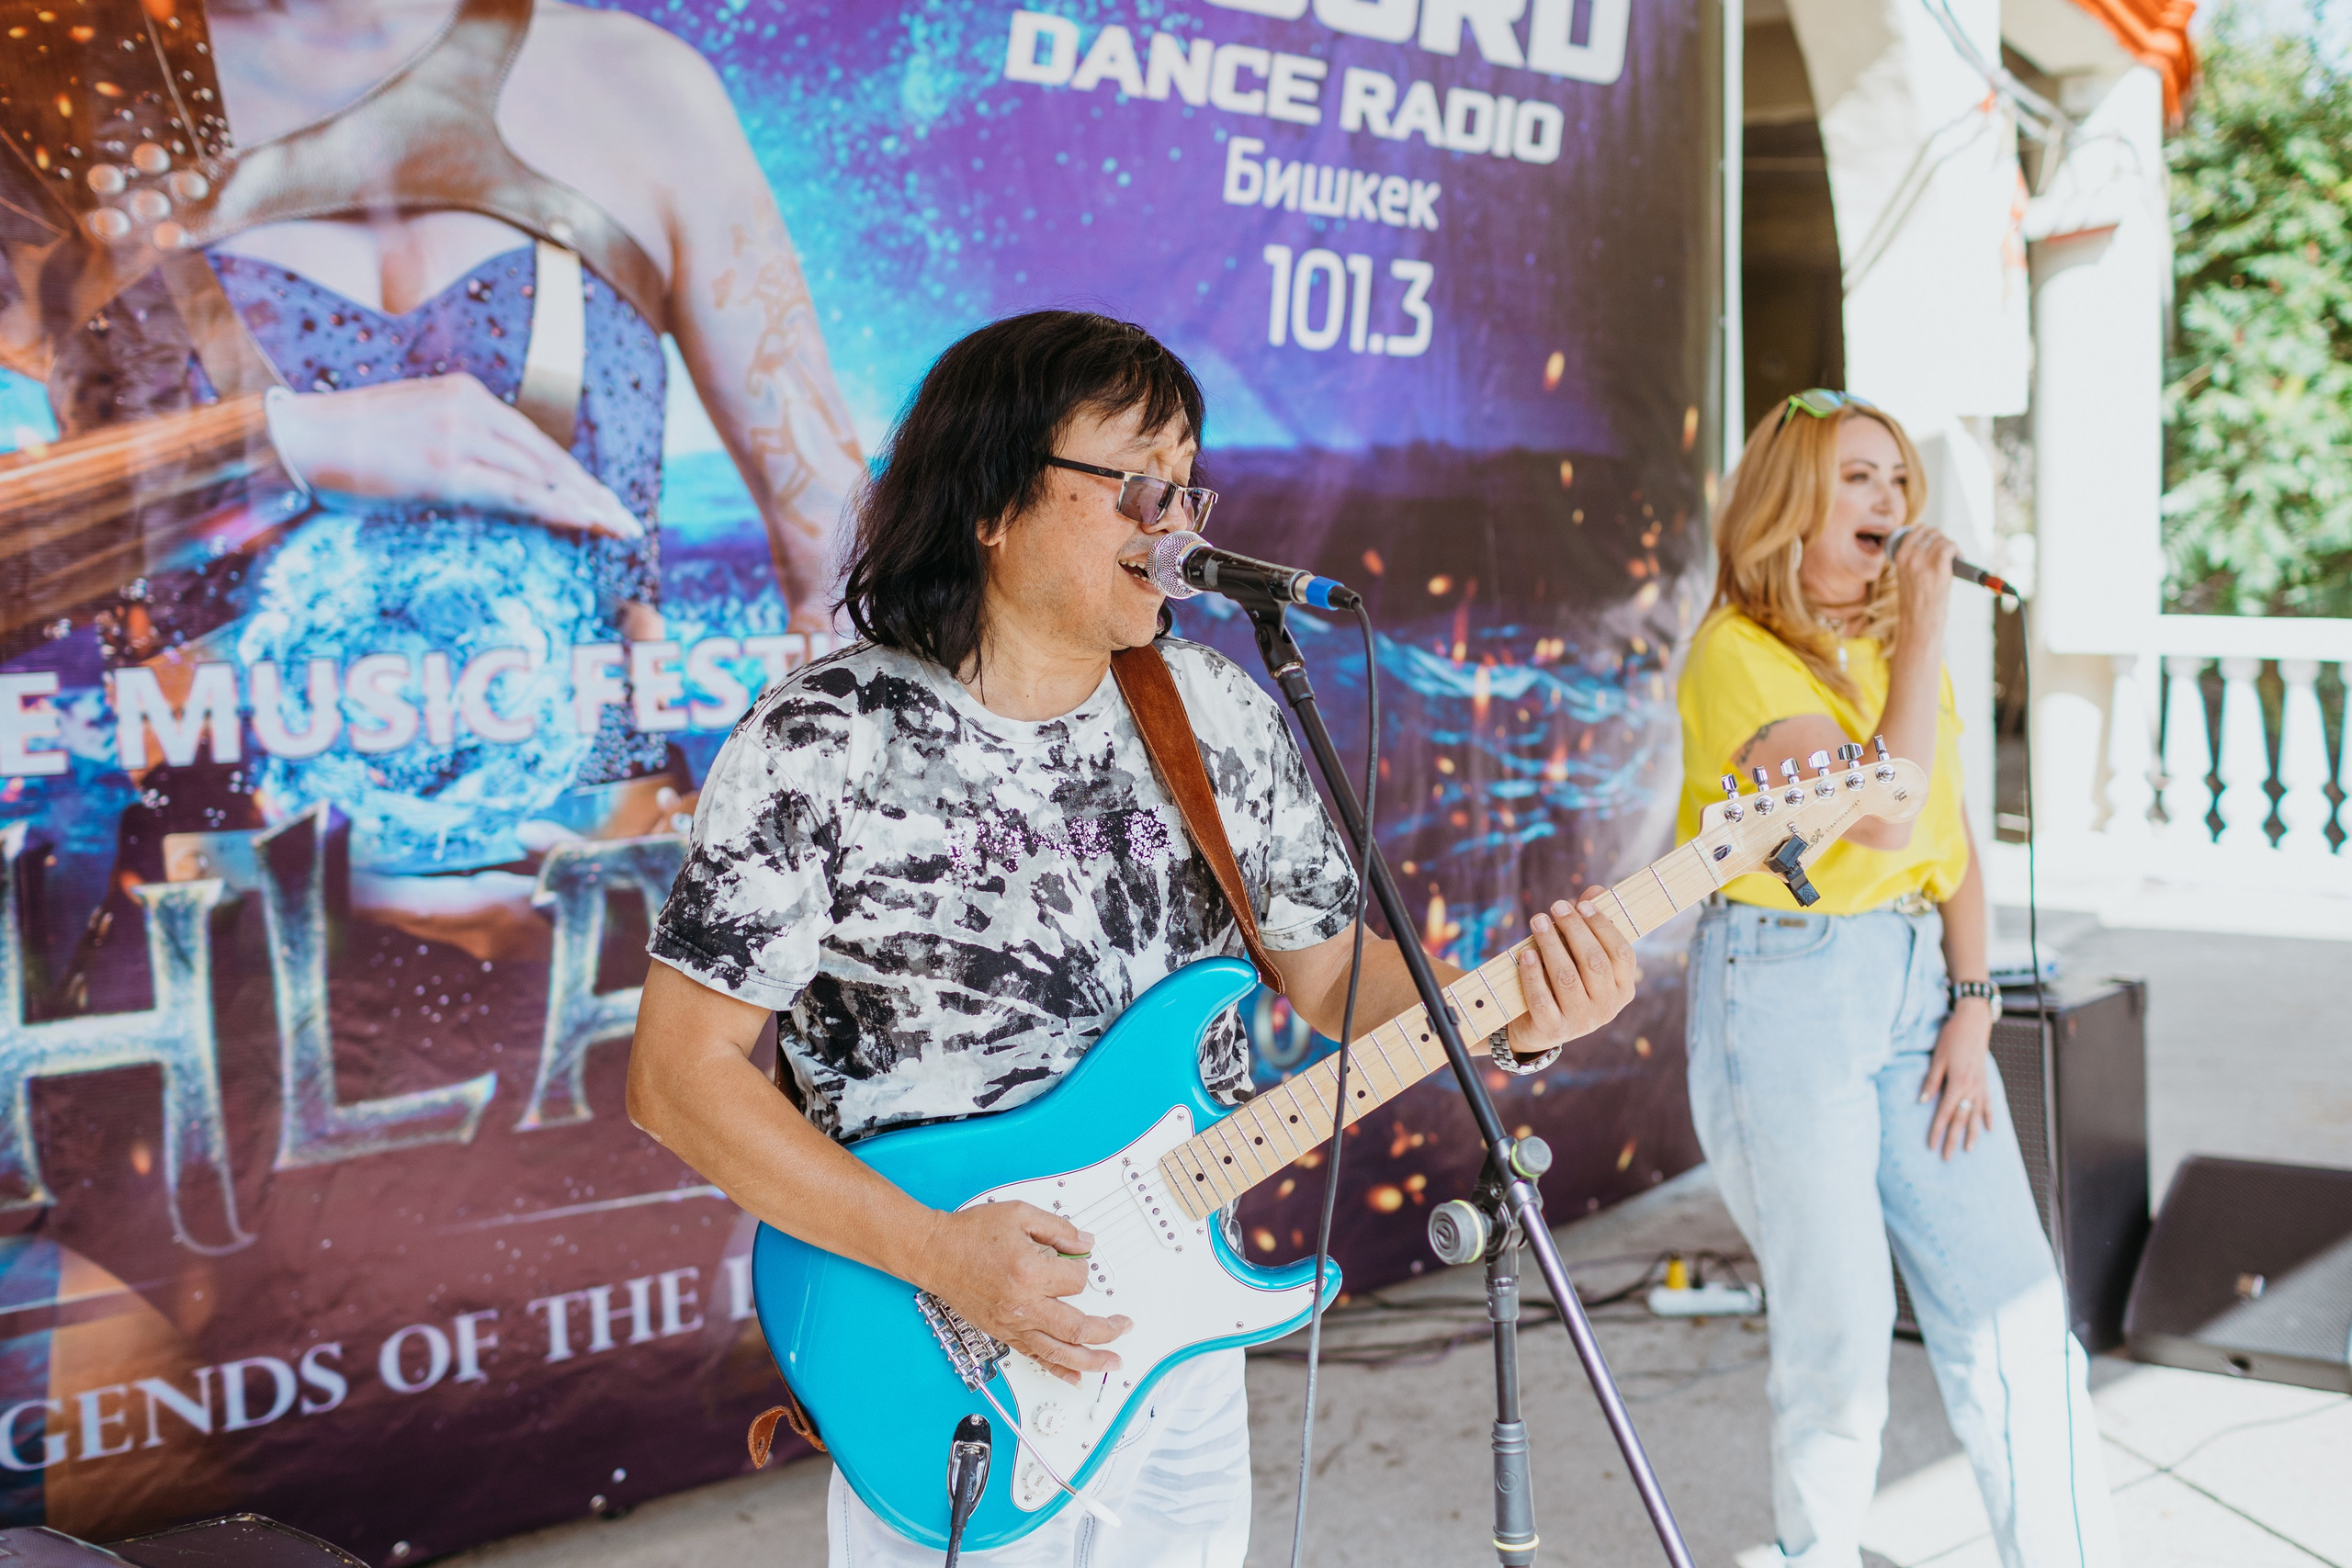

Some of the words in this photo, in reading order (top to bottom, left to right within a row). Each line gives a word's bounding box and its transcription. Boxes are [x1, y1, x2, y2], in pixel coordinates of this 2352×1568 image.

[1004, 8, 1329, 126] DANCE
[1339, 66, 1565, 165] RADIO
[1222, 135, 1442, 231] Бишкек
[1261, 244, 1435, 357] 101.3
[114, 647, 537, 773] MUSIC
[571, 631, 831, 736] FEST
[0, 1341, 348, 1472] GENDS
[378, 1308, 500, 1395] OF
[526, 1265, 705, 1366] THE
